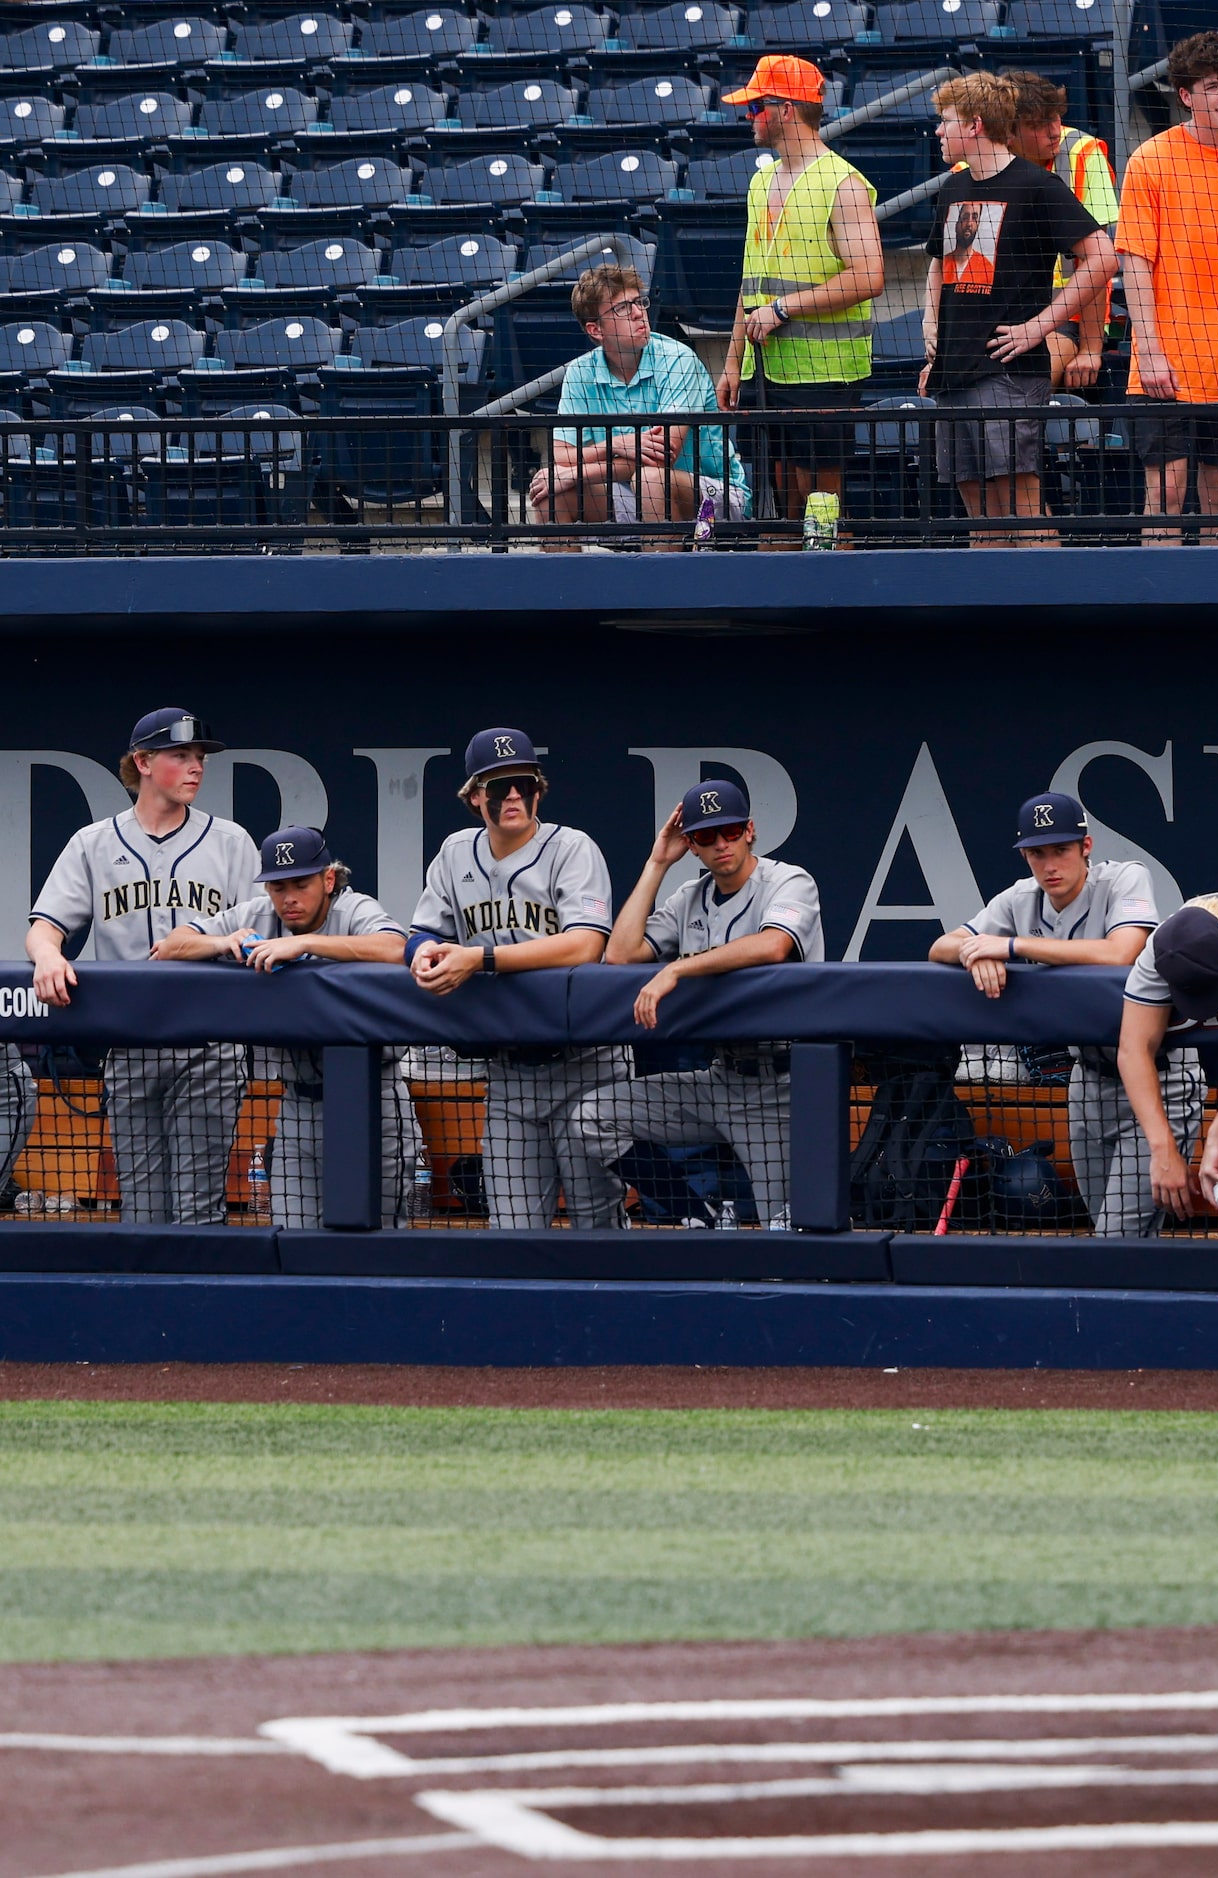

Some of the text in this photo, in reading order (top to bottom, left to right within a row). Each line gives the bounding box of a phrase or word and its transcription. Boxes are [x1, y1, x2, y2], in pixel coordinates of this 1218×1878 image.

[494, 735, 516, 758] K
[700, 791, 722, 815] K
[1033, 804, 1054, 828] K
[275, 842, 295, 866] K
[103, 878, 222, 921] INDIANS
[462, 897, 560, 941] NDIANS
